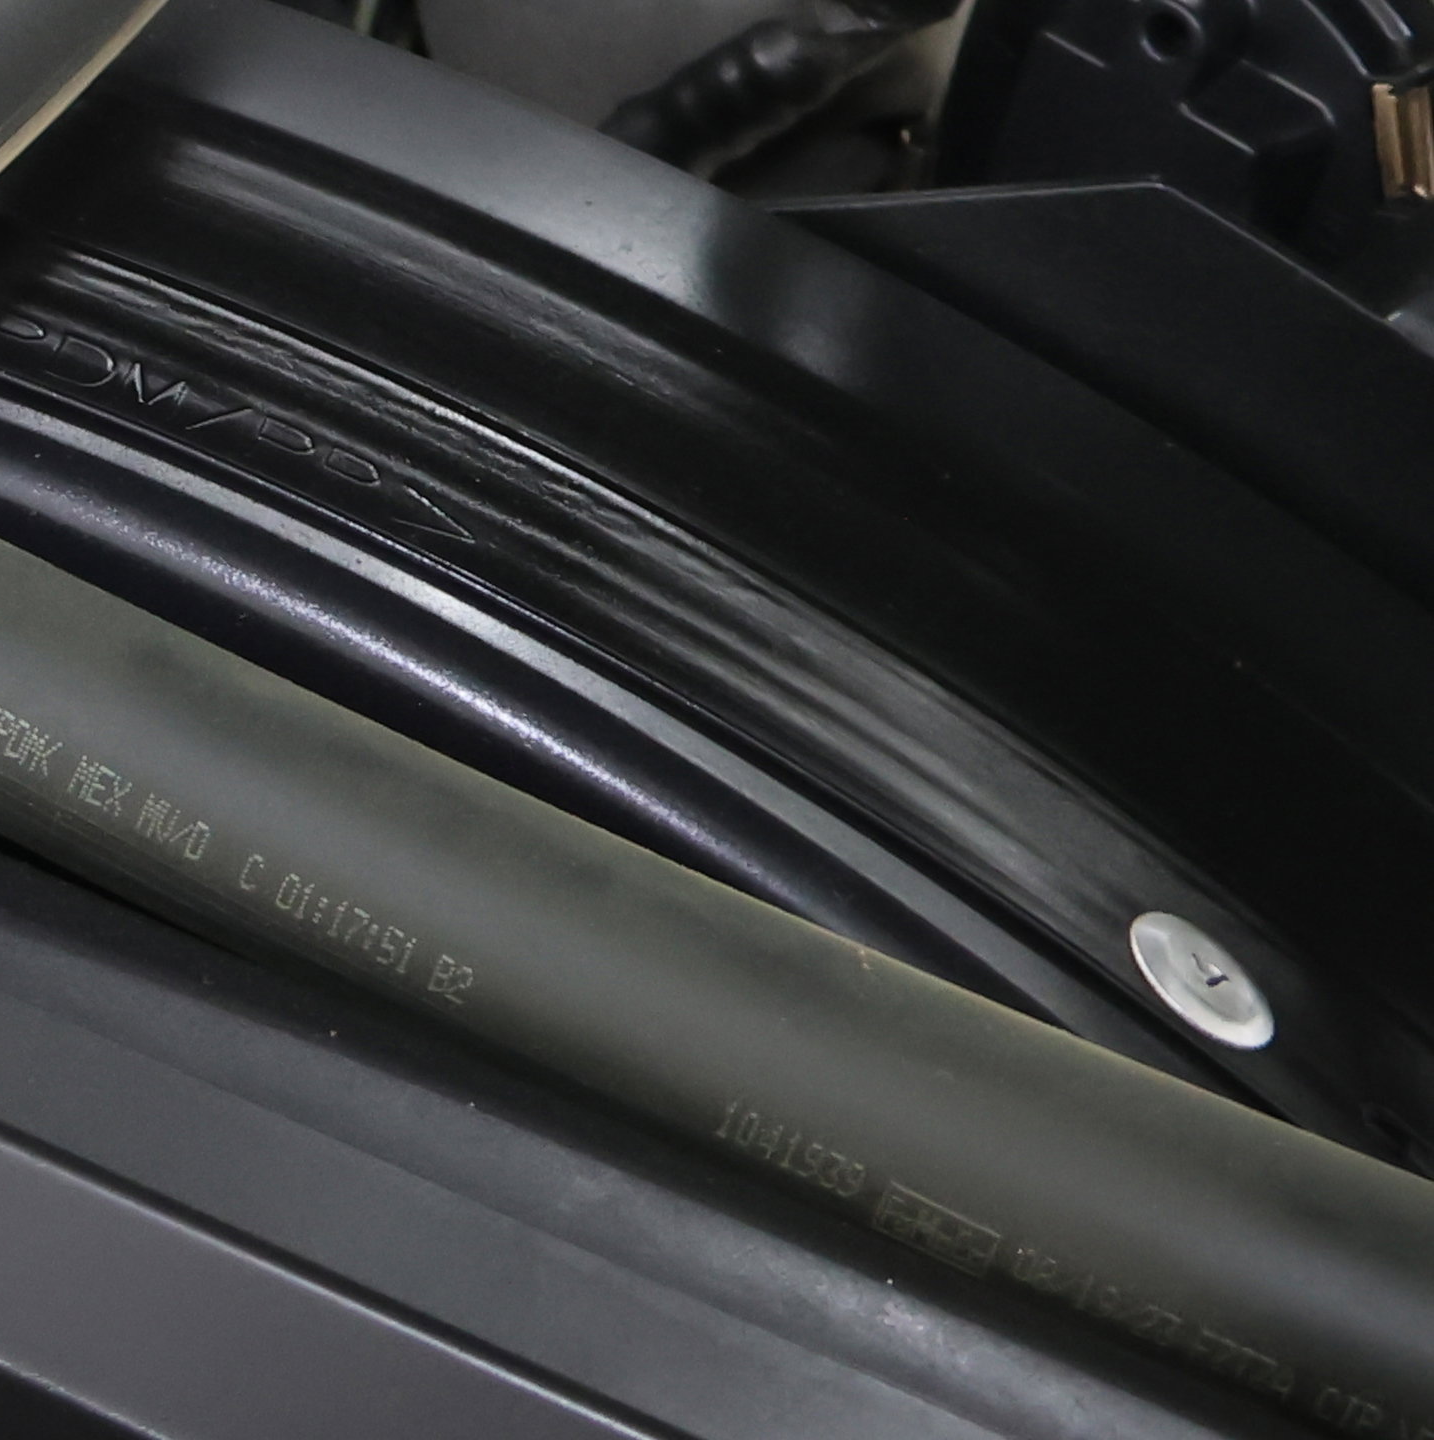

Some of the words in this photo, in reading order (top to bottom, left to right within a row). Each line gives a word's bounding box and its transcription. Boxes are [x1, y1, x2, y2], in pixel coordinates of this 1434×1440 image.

[66, 754, 134, 818] MEX
[239, 853, 265, 892] C
[427, 953, 475, 1005] B2
